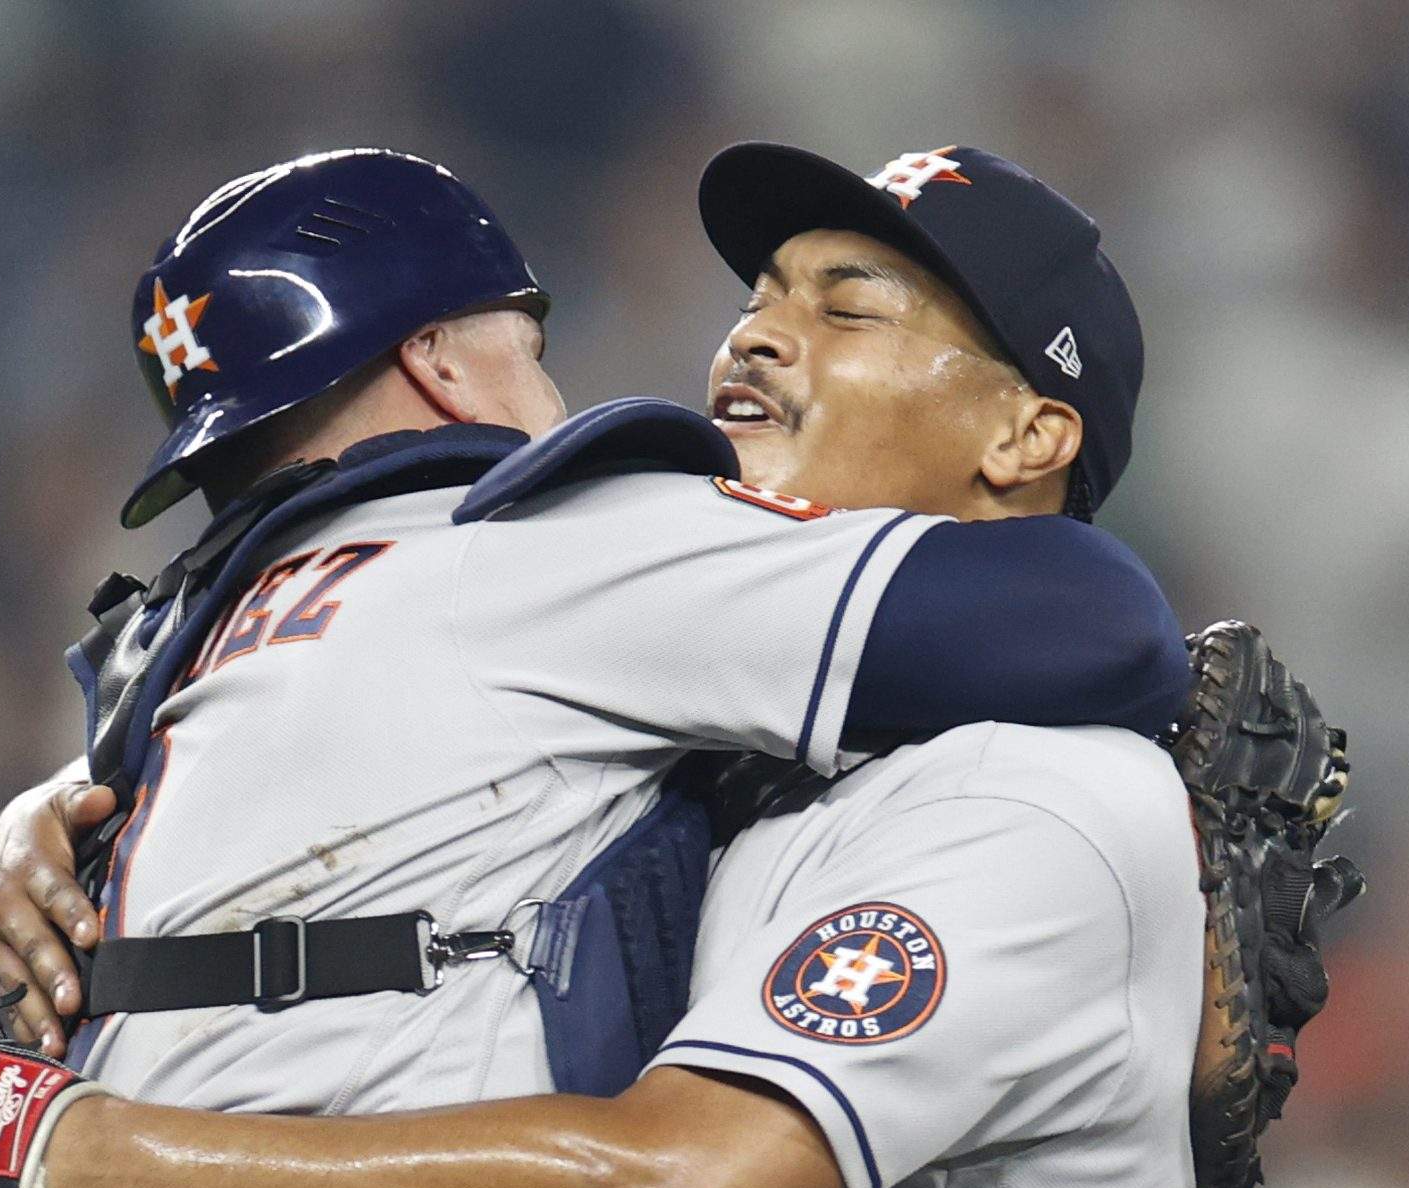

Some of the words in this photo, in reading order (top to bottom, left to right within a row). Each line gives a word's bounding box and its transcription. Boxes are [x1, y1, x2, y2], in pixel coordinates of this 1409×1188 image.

[864, 152, 961, 201] H
[143, 294, 210, 386] H
[815, 911, 936, 970] HOUSTON
[809, 946, 894, 1006] H
[773, 993, 881, 1037] ASTROS
